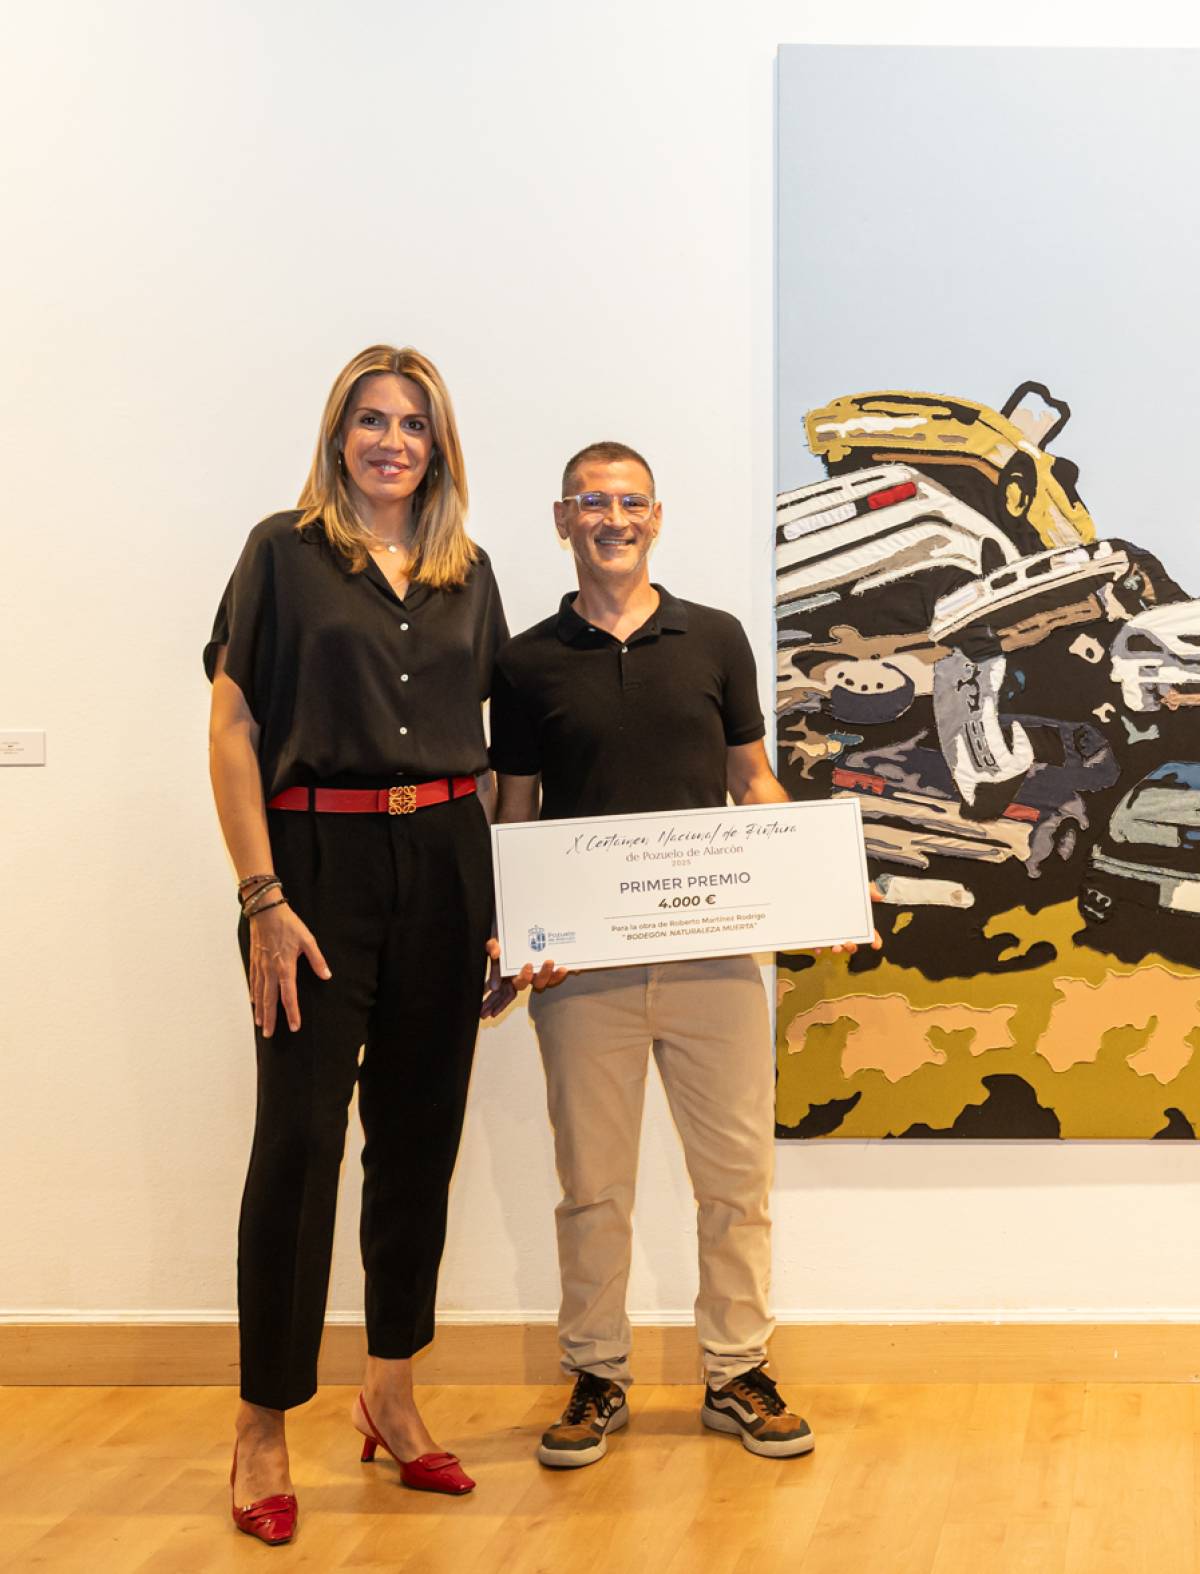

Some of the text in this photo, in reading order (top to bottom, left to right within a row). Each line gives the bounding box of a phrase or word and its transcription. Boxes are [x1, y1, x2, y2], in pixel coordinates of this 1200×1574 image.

[657, 824, 722, 846] Nacional
[625, 843, 744, 862] de Pozuelo de Alarcón
[671, 859, 691, 867] 2025
[620, 871, 751, 894] PRIMER PREMIO
[658, 894, 717, 909] 4.000 €
[737, 913, 766, 921] Rodrigo
